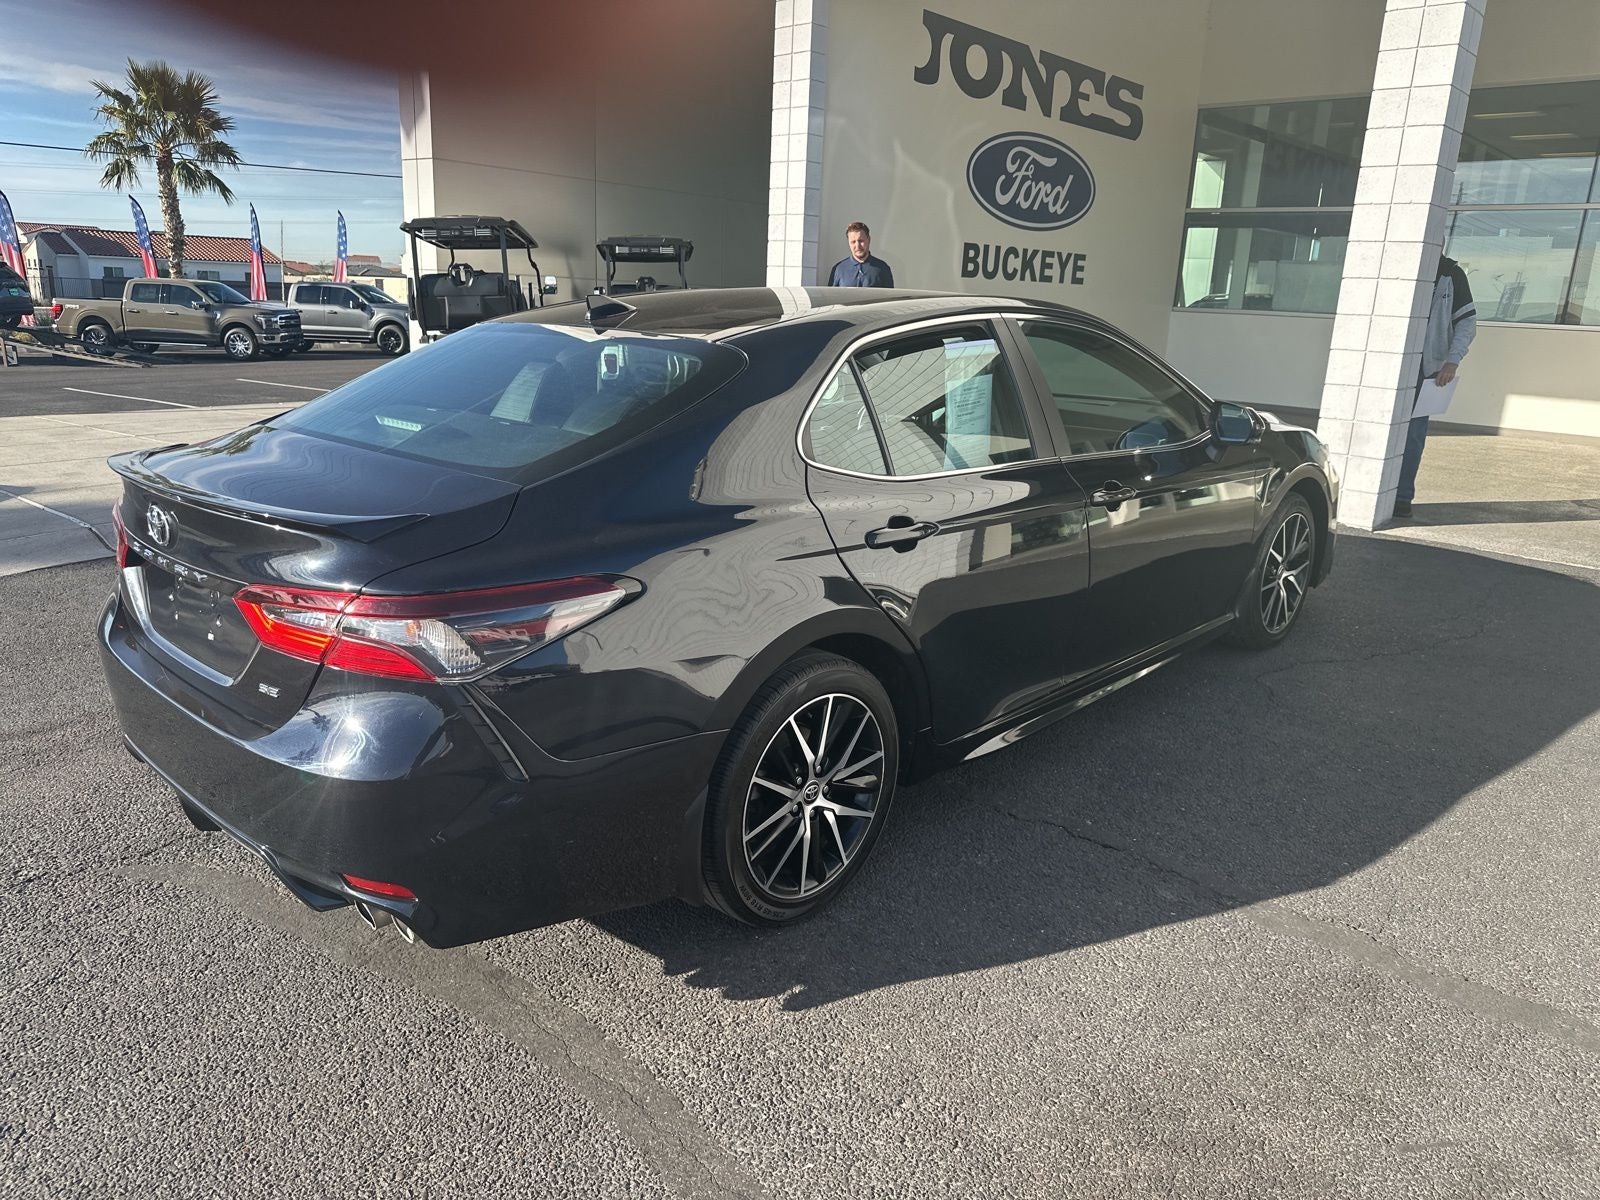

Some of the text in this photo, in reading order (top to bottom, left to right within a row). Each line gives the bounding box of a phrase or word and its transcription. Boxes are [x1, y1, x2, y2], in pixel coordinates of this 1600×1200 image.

[913, 8, 1145, 142] JONES
[995, 146, 1074, 215] Ford
[961, 242, 1087, 285] BUCKEYE
[258, 683, 280, 698] SE
